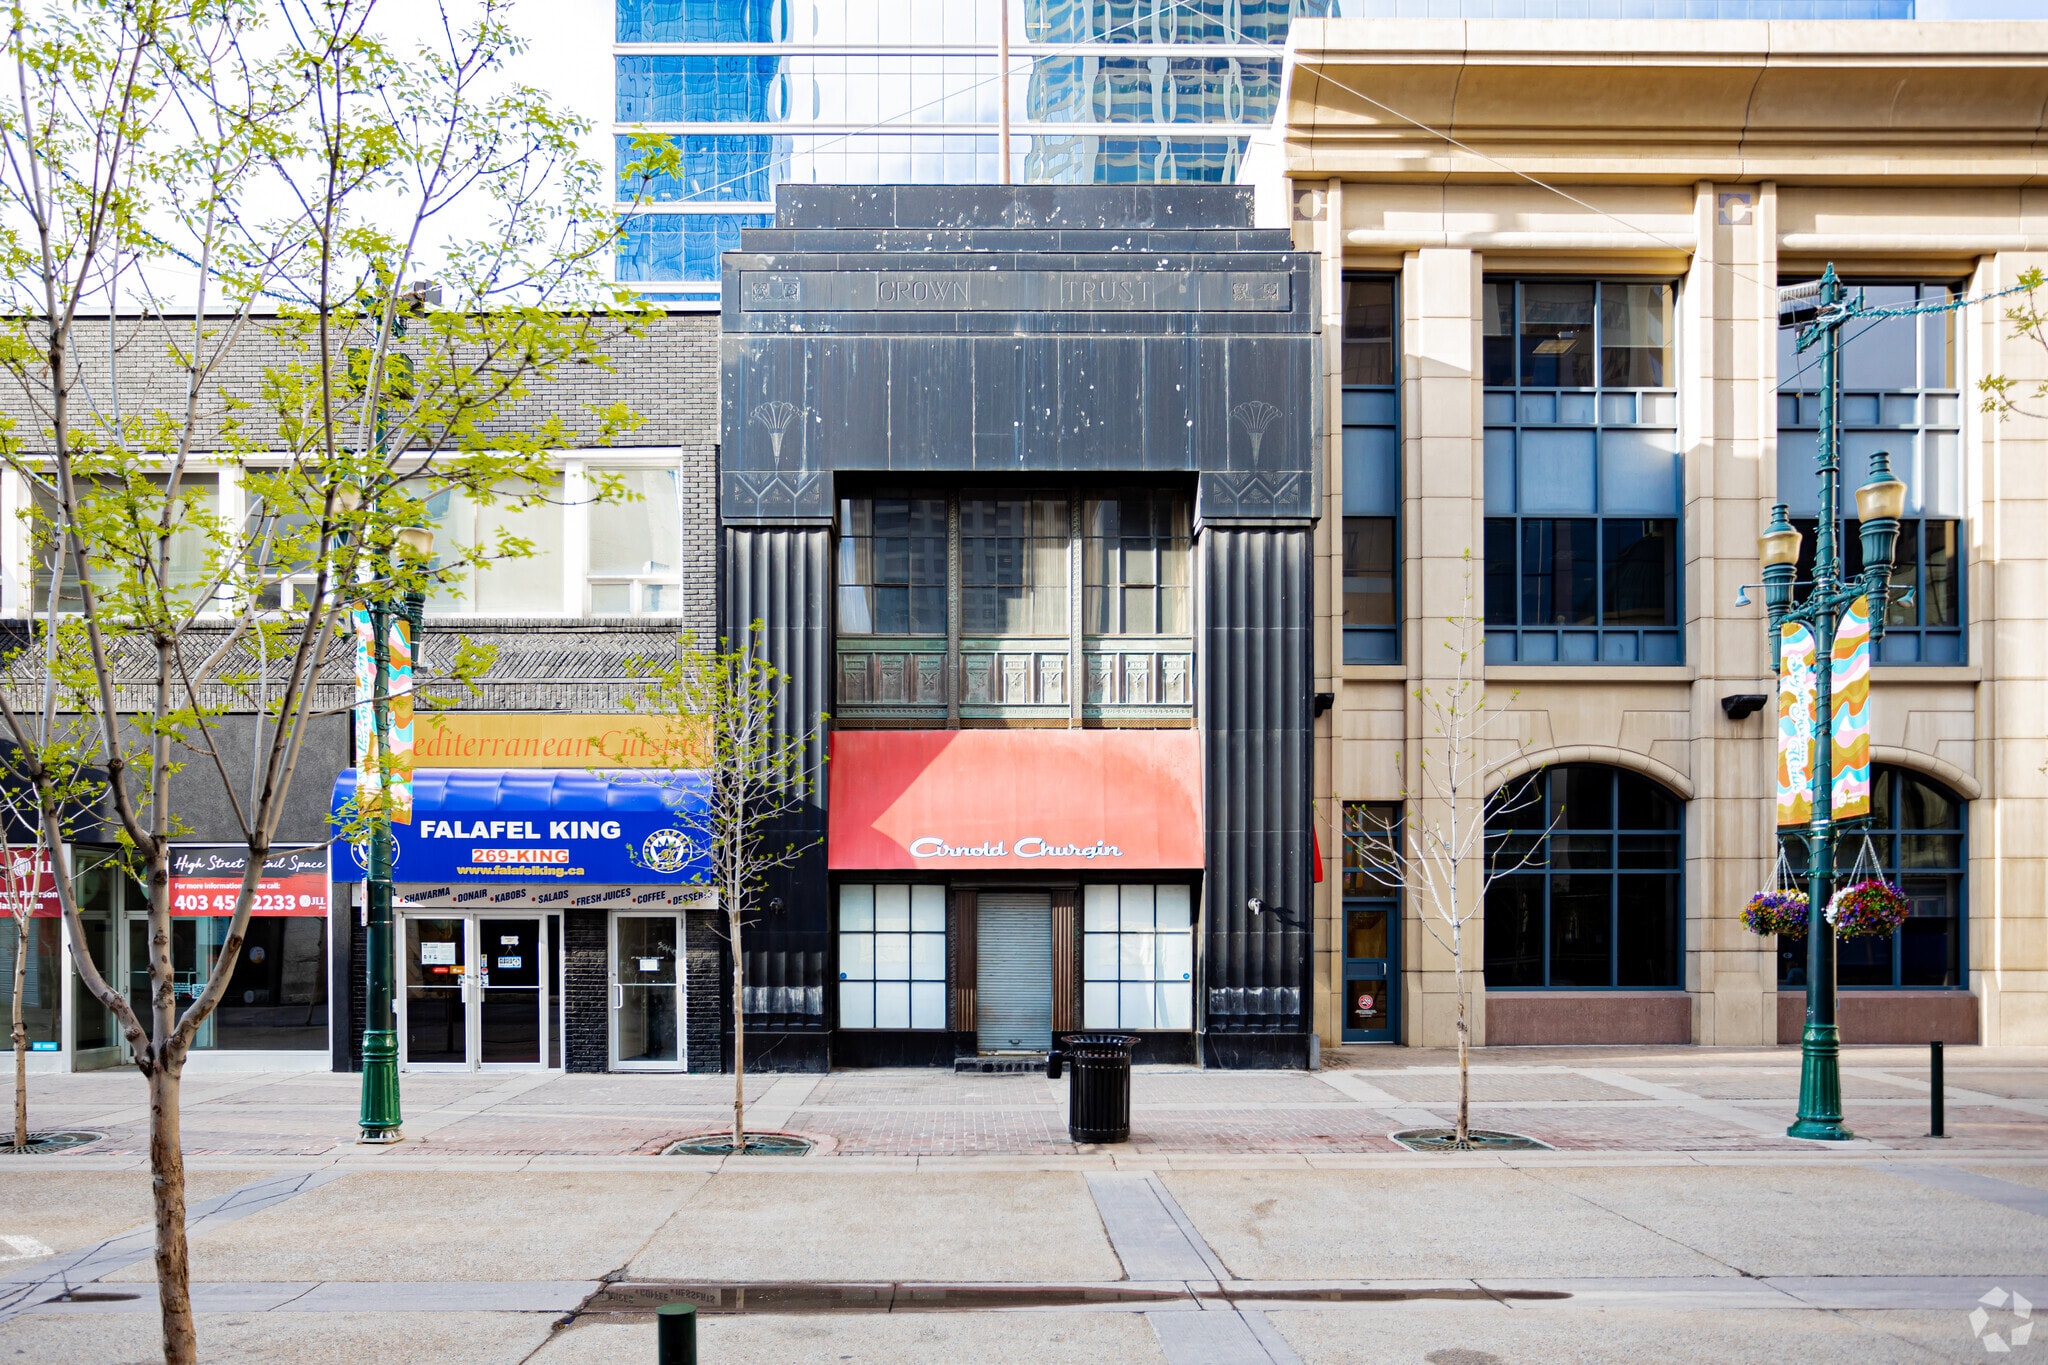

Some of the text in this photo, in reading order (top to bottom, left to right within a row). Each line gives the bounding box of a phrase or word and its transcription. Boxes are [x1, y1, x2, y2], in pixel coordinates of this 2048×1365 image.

[879, 281, 1151, 301] CROWN TRUST
[413, 725, 703, 757] editerranean Cuisine
[420, 821, 621, 839] FALAFEL KING
[473, 849, 569, 862] 269-KING
[1012, 836, 1124, 859] Churgin
[174, 855, 206, 874] High
[207, 855, 245, 871] Street
[288, 855, 326, 872] Space
[456, 865, 585, 877] www.falafelking.ca
[174, 894, 296, 911] 403 45 2233
[404, 887, 450, 903] SHAWARMA
[457, 889, 488, 903] DONAIR
[494, 889, 527, 903] KABOBS
[538, 889, 569, 903] SALADS
[576, 894, 601, 906] FRESH
[603, 888, 631, 901] JUICES
[637, 891, 666, 904] COFFEE
